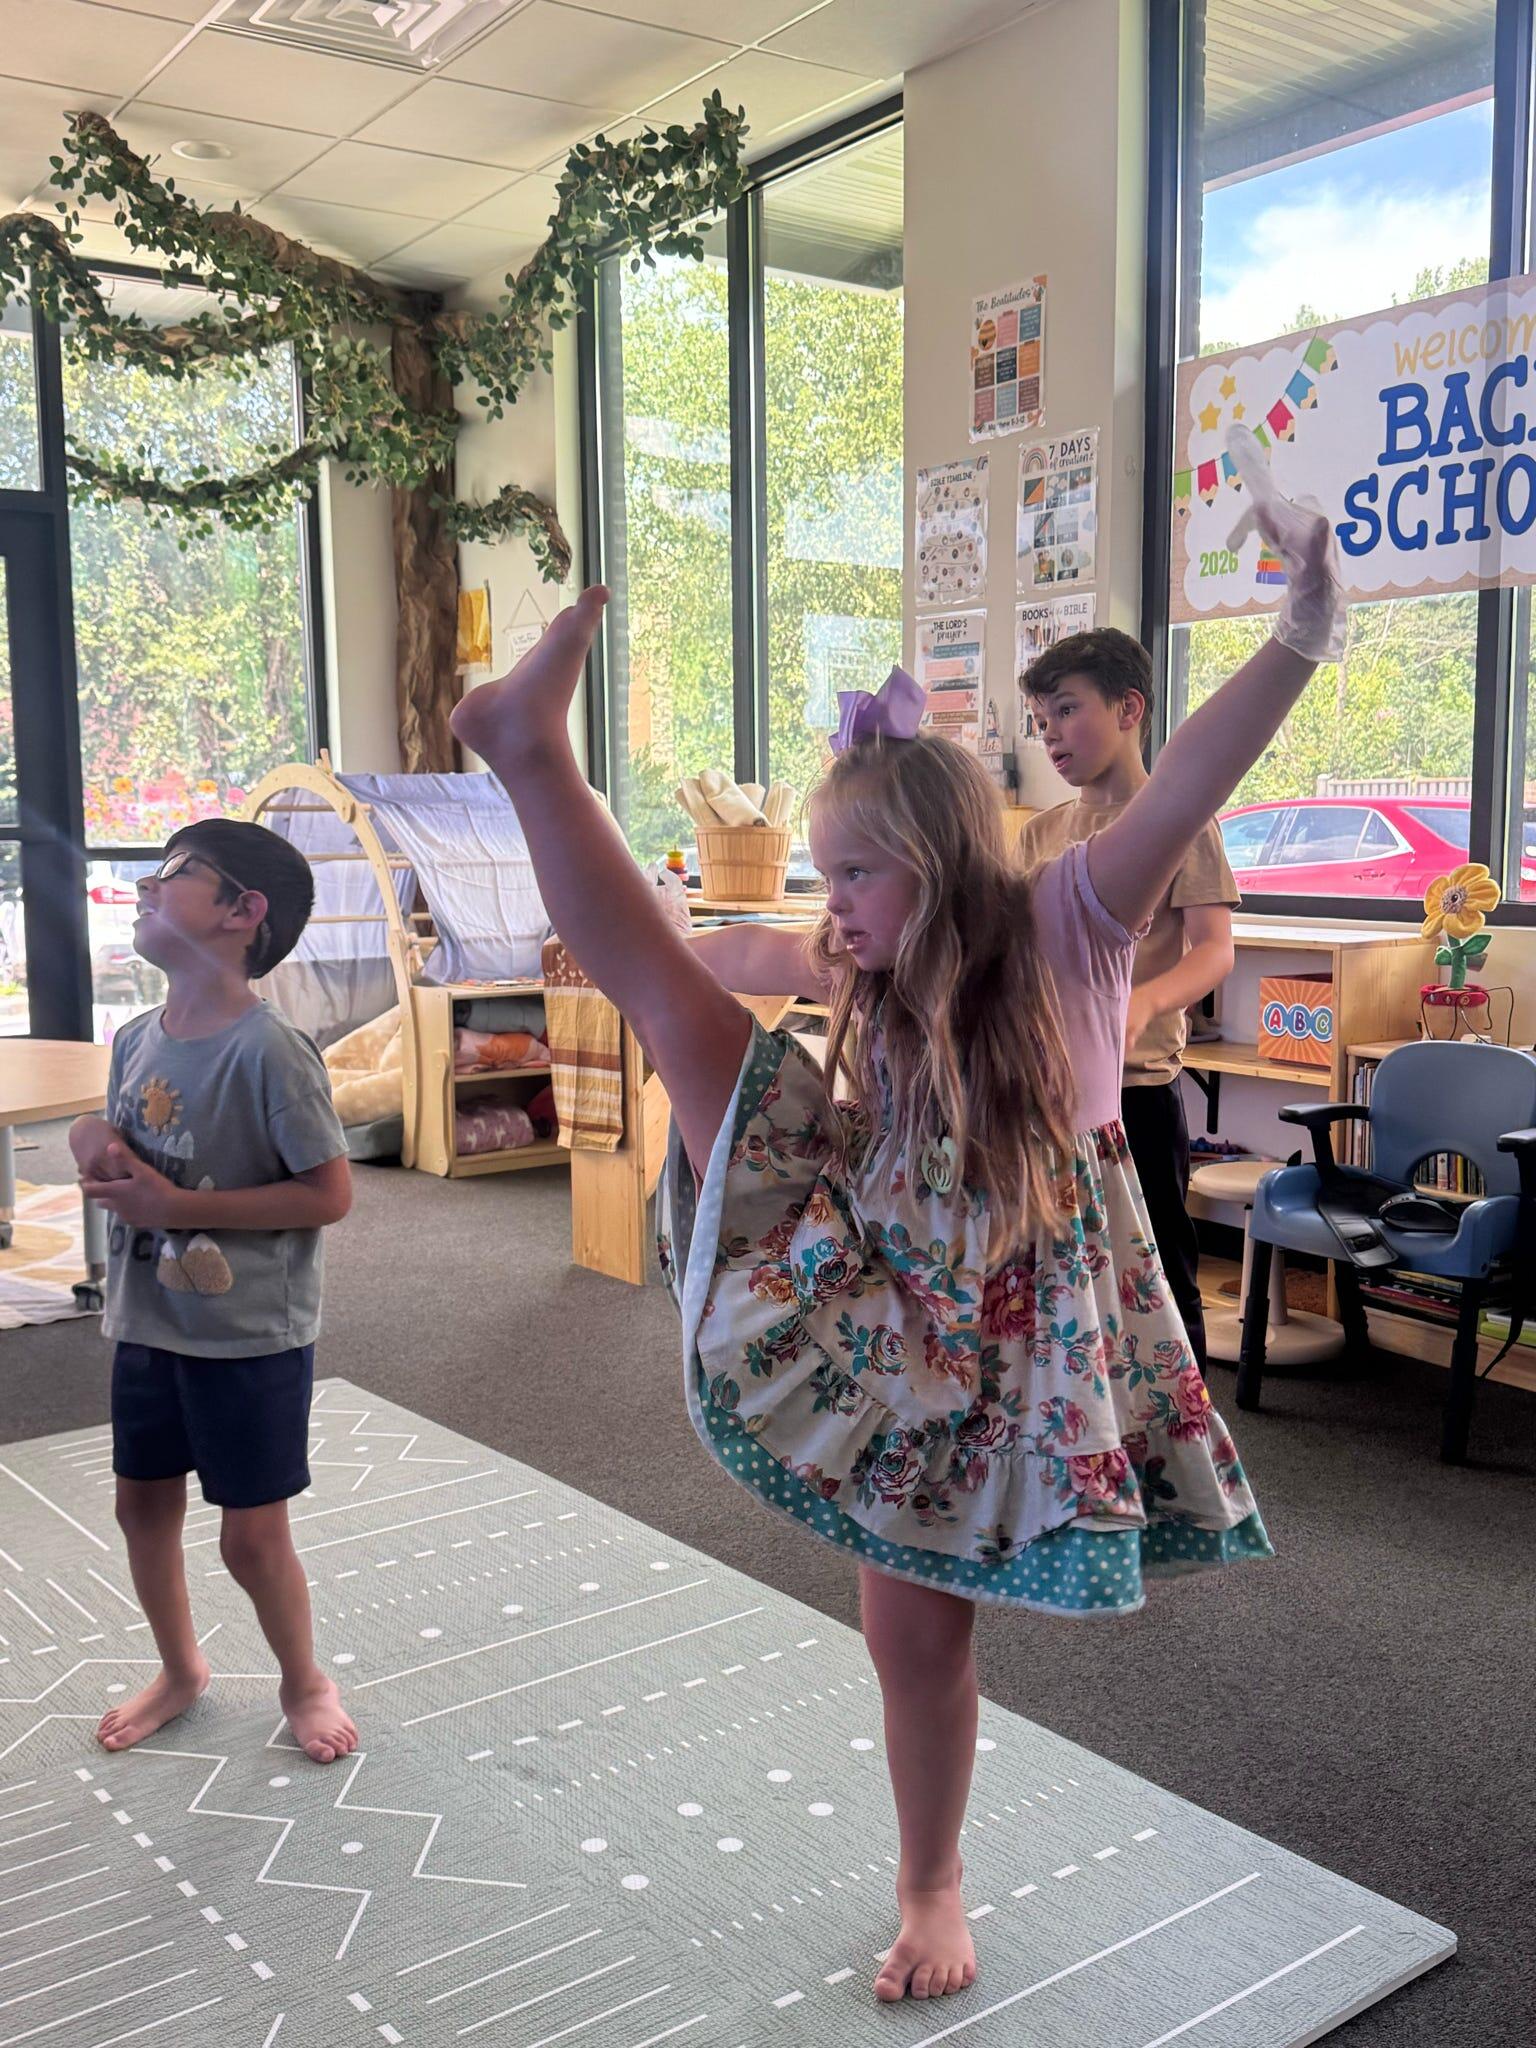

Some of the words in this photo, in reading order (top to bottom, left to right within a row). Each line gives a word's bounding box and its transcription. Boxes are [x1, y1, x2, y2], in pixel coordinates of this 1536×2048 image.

[976, 300, 988, 313] The
[991, 287, 1031, 310] Beatitudes
[1377, 354, 1536, 466] BAC
[1049, 445, 1055, 460] 7
[1060, 436, 1091, 458] DAYS
[1199, 549, 1239, 577] 2026
[1022, 608, 1048, 621] BOOKS
[1063, 602, 1087, 616] BIBLE
[933, 621, 944, 631] THE
[946, 618, 967, 630] LORD'S
[936, 630, 962, 643] prayer
[1268, 1007, 1330, 1036] ABC
